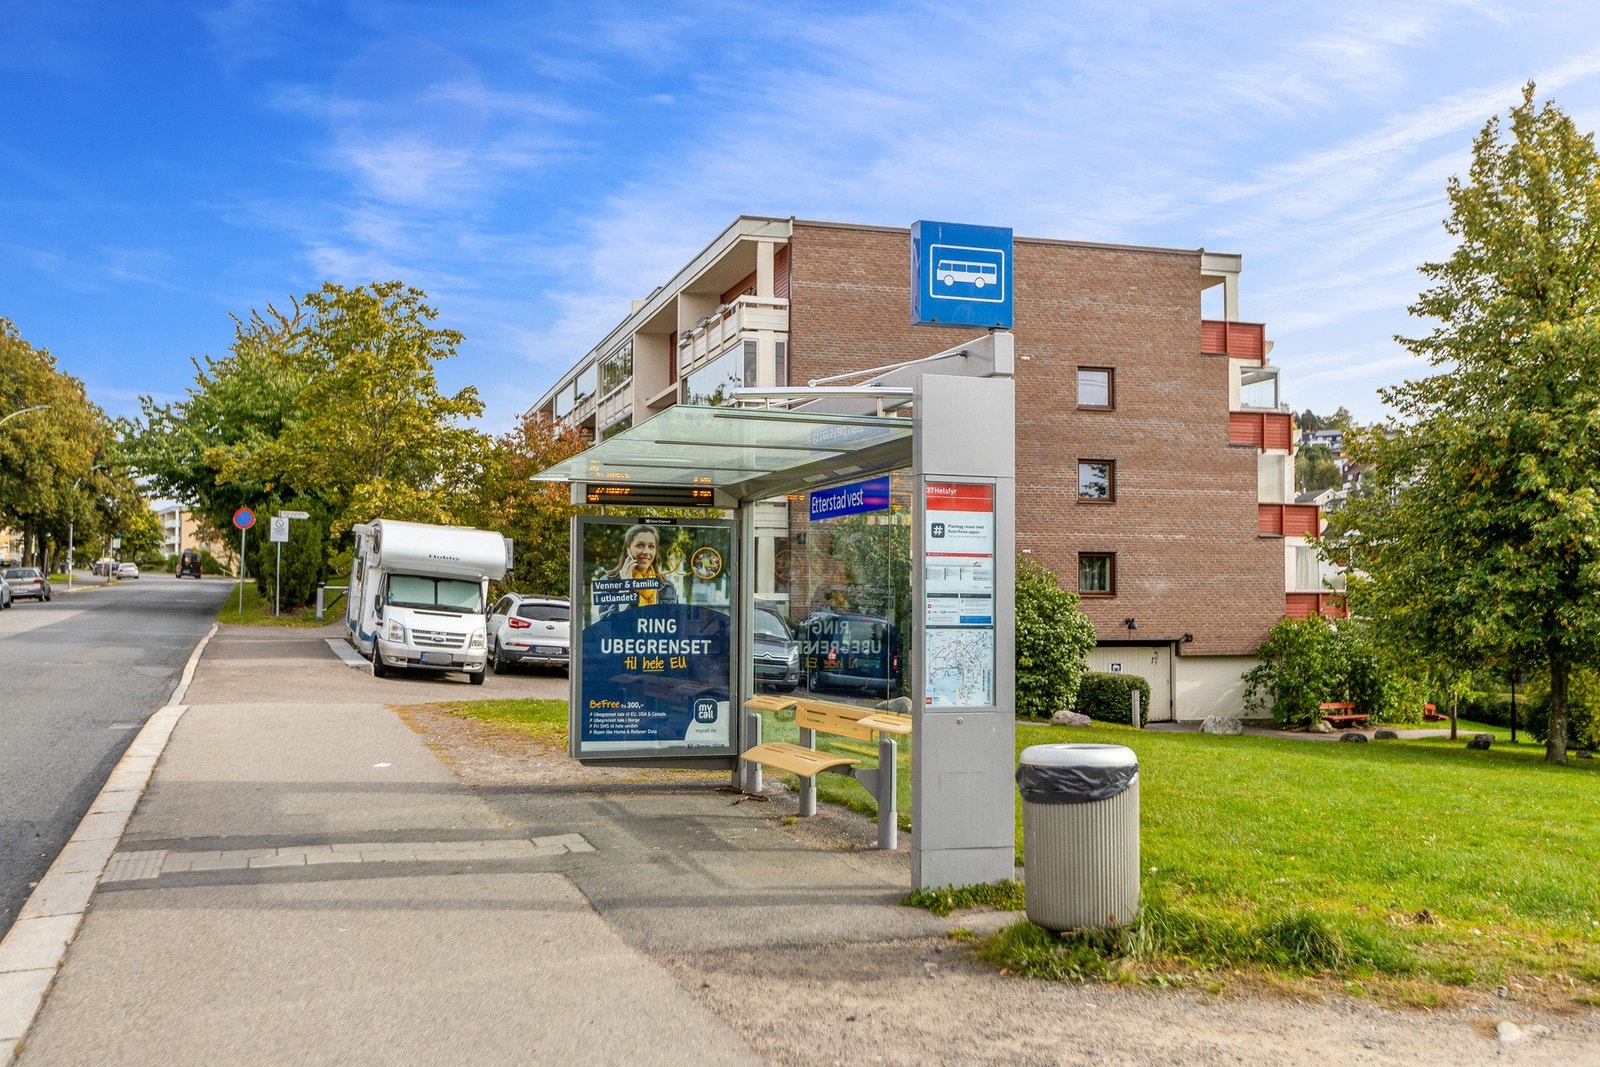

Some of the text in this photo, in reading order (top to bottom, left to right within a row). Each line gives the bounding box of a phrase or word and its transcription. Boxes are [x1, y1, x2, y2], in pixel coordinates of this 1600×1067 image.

[812, 488, 864, 513] Etterstad vest
[595, 579, 659, 590] Venner & familie
[596, 593, 638, 603] i utlandet?
[637, 618, 677, 634] RING
[601, 638, 712, 654] UBEGRENSET
[624, 656, 687, 670] til hele EU
[589, 699, 620, 709] BeFree
[698, 704, 712, 712] my
[698, 710, 714, 718] call
